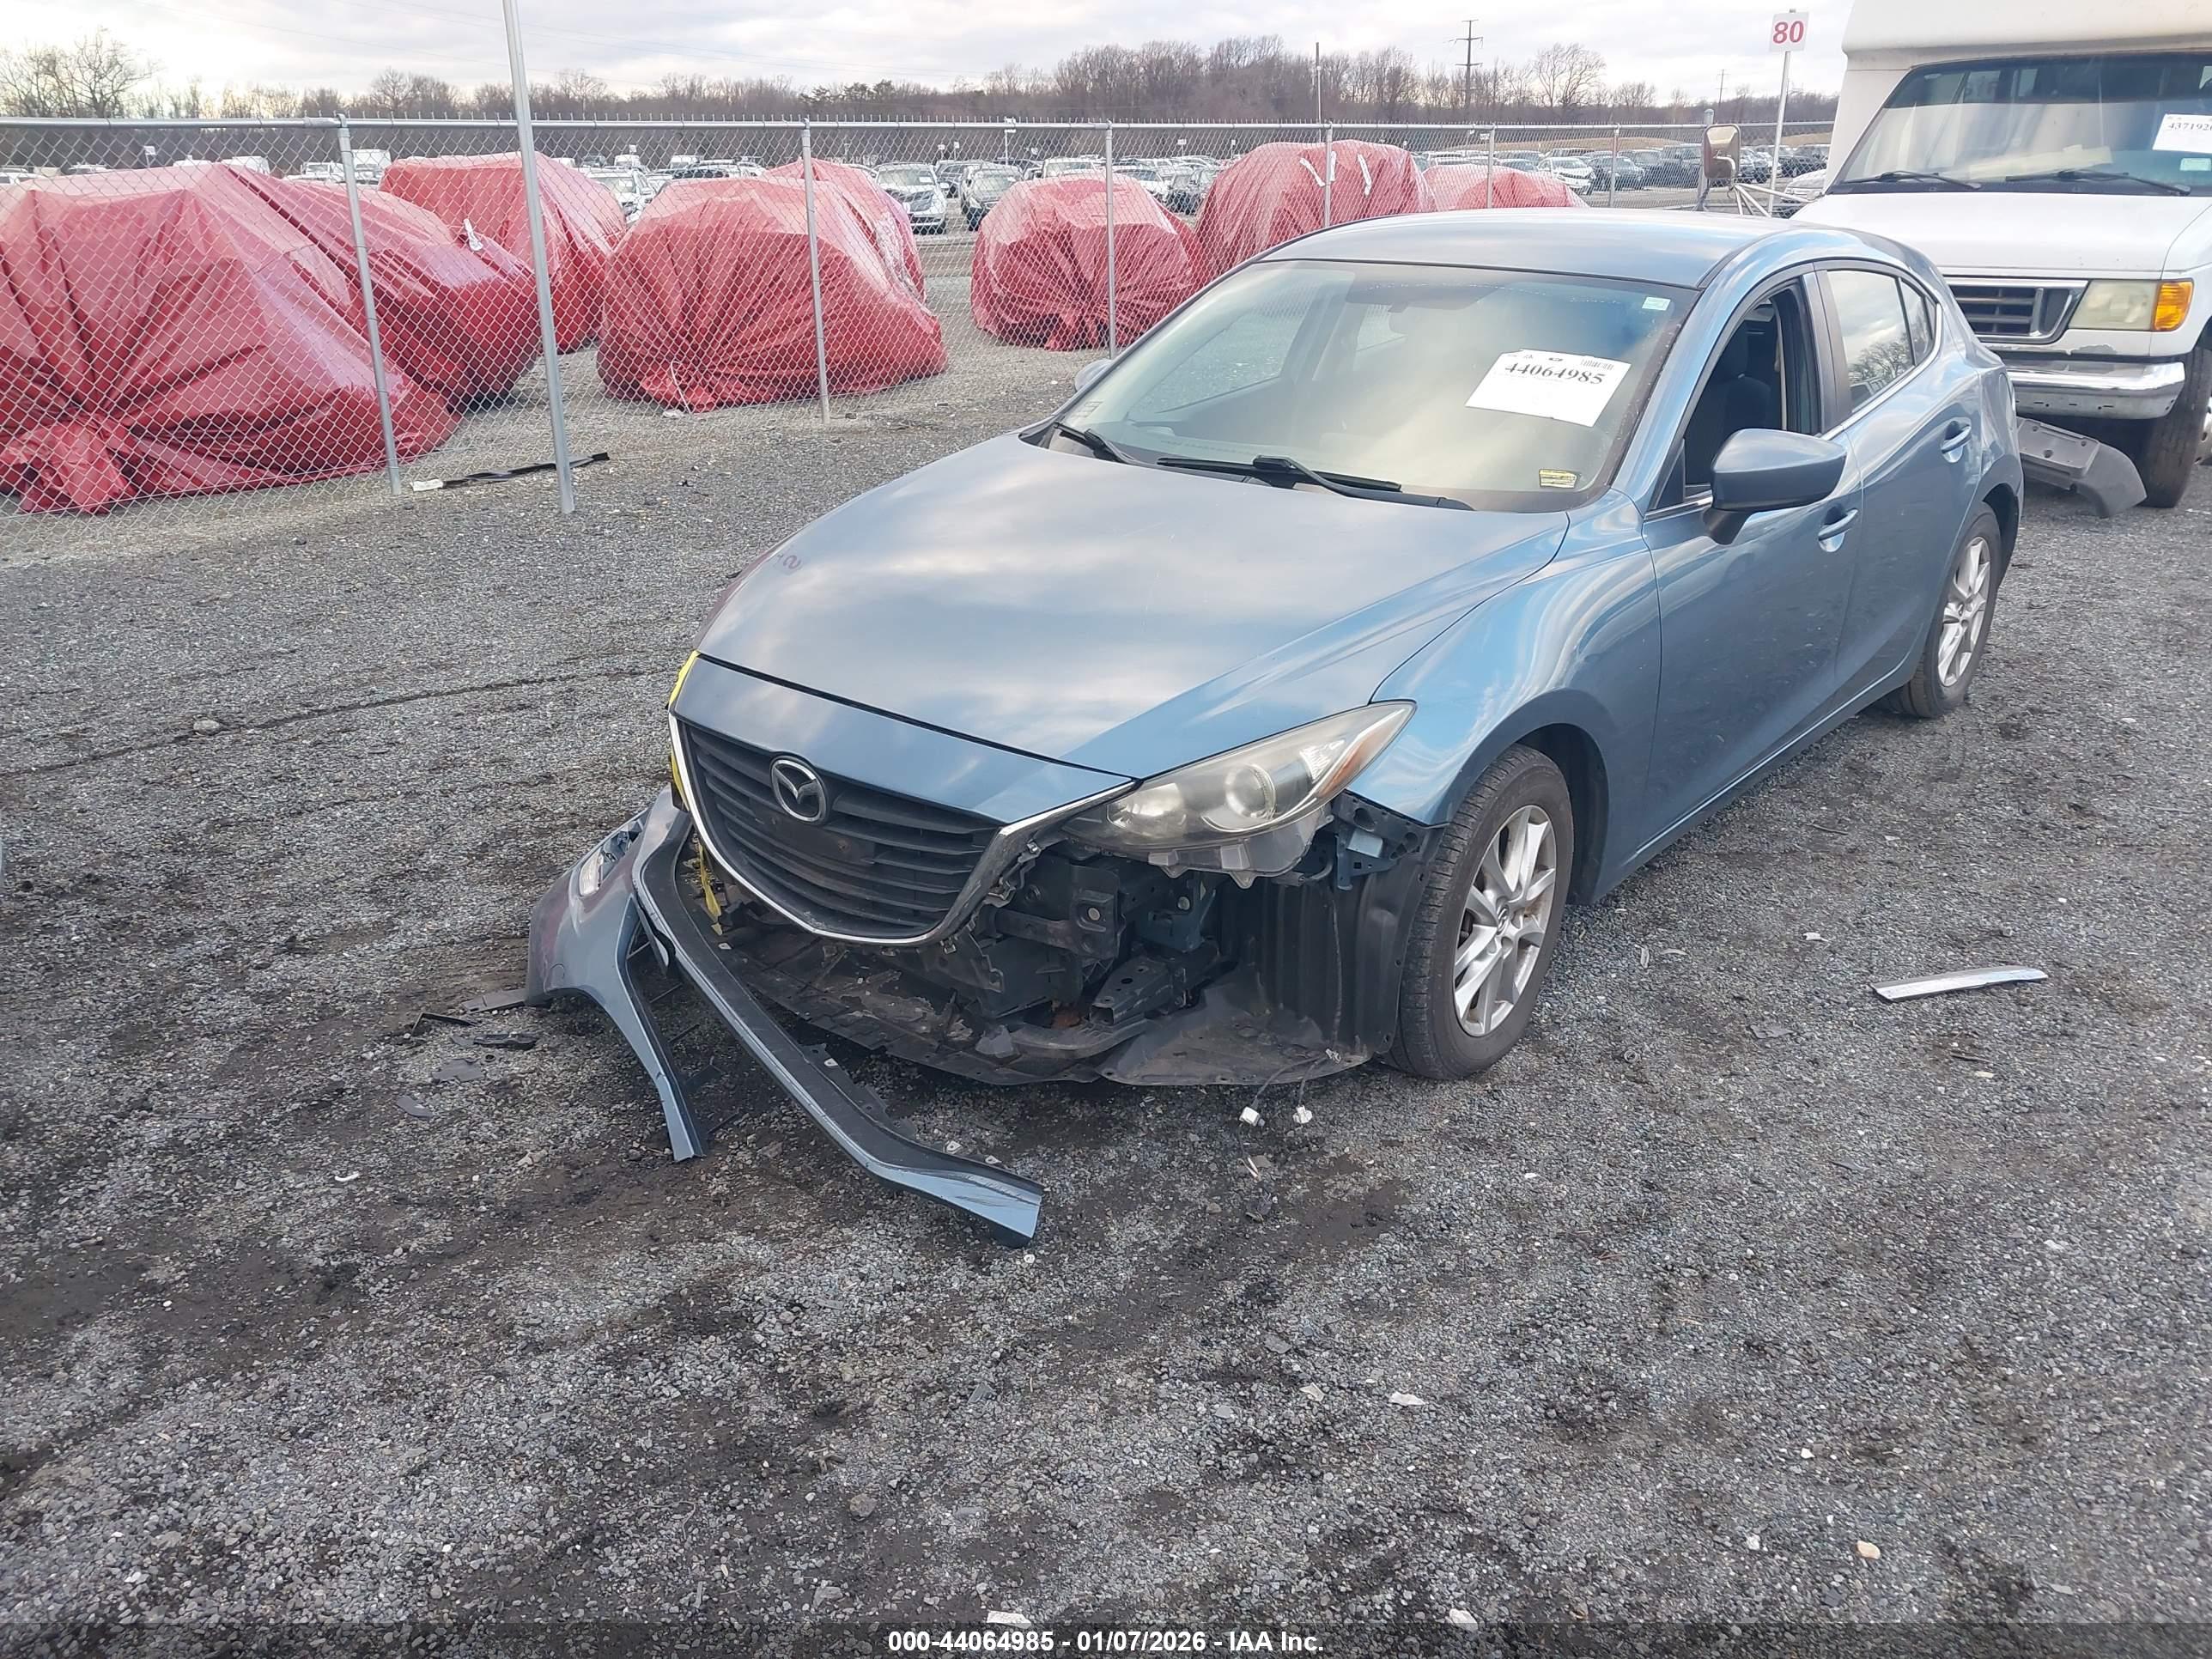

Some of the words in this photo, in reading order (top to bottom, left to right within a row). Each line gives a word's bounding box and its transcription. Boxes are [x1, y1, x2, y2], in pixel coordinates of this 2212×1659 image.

[1773, 21, 1804, 44] 80
[2167, 122, 2212, 131] 437192
[1504, 362, 1606, 385] 44064985
